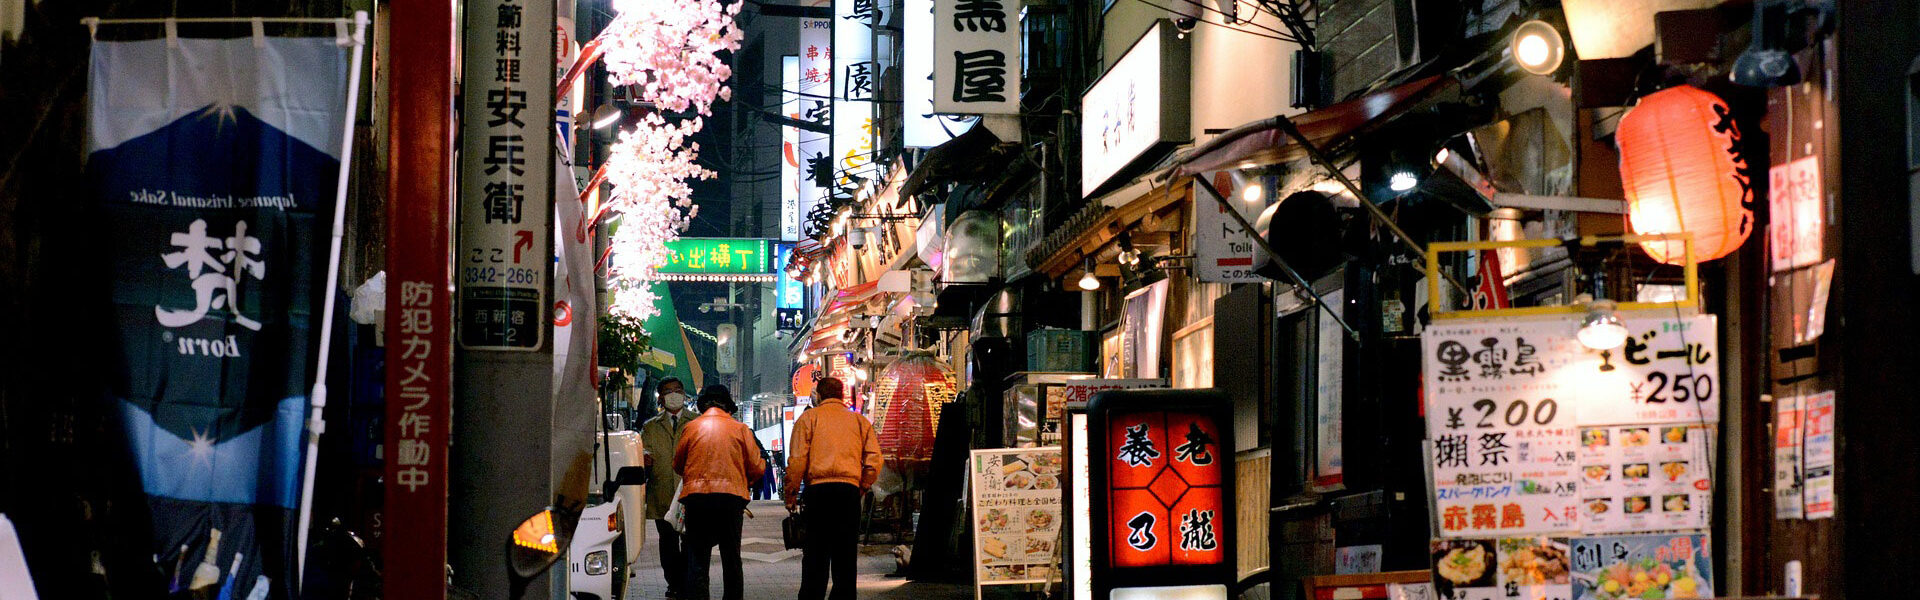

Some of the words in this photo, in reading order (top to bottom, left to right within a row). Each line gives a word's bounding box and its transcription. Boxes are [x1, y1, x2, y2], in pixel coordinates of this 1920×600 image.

[483, 87, 527, 224] 安兵衛
[471, 248, 504, 263] ここ
[656, 244, 753, 270] い出横丁
[465, 267, 540, 284] 3342-2661
[474, 310, 525, 325] 西新宿
[397, 281, 433, 492] 防犯カメラ作動中
[1630, 371, 1712, 404] ¥250
[1445, 398, 1558, 429] ¥200
[1434, 432, 1511, 469] 獺祭
[1443, 502, 1525, 531] 赤霧島
